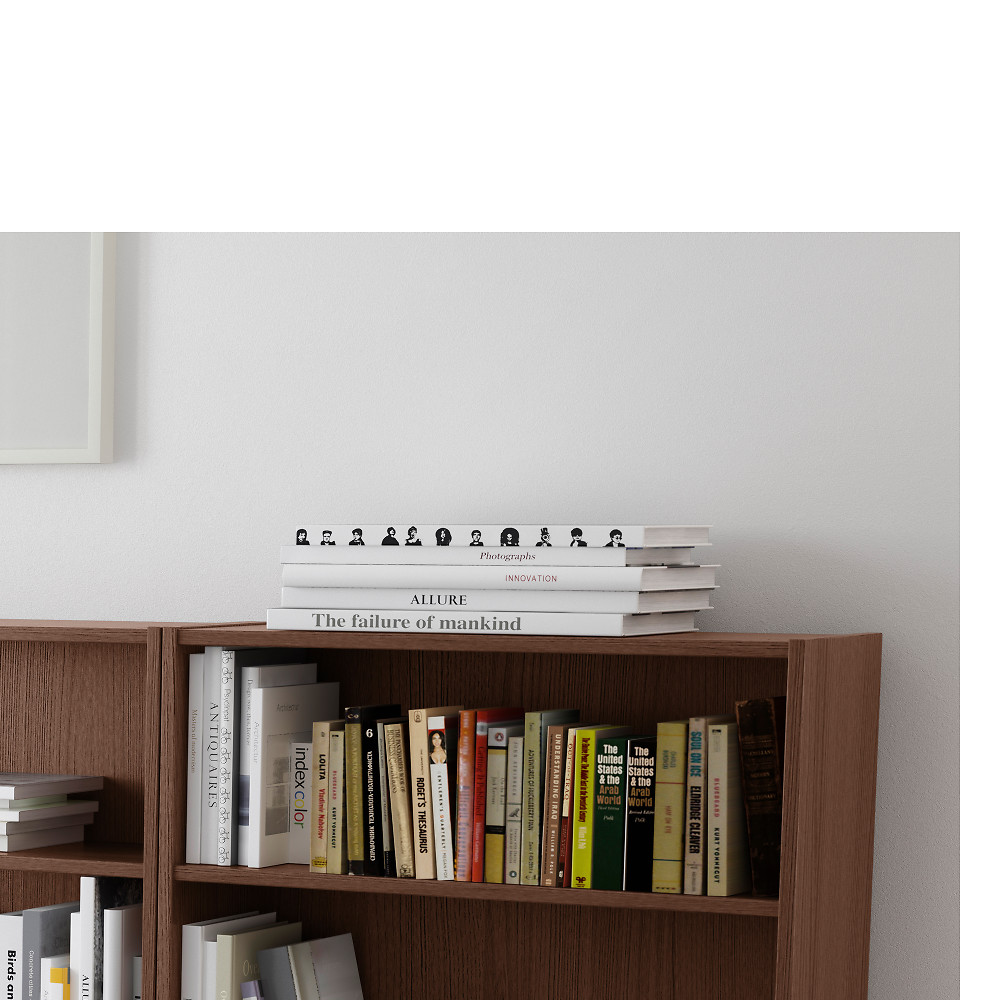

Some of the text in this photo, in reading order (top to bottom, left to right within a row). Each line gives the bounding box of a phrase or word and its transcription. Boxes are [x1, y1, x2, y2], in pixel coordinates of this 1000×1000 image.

[480, 551, 536, 562] Photographs
[505, 574, 558, 583] INNOVATION
[410, 594, 467, 606] ALLURE
[311, 613, 522, 631] The failure of mankind
[365, 728, 374, 738] 6
[602, 744, 618, 754] The
[633, 747, 649, 757] The
[207, 702, 219, 809] ANTIQUAIRES
[597, 754, 624, 764] United
[552, 733, 561, 799] UNDERSTANDING
[628, 757, 655, 767] United
[318, 754, 326, 781] LOLITA
[597, 765, 624, 774] States
[628, 767, 655, 777] States
[599, 775, 620, 785] & the
[630, 777, 652, 787] & the
[294, 747, 309, 829] index color
[415, 777, 426, 808] ROGET'S
[599, 785, 620, 795] Arab
[630, 787, 651, 797] Arab
[689, 731, 702, 854] SOUL ON ICE ELDRIDGE CLEAVER
[318, 788, 326, 813] Vladimir
[596, 795, 622, 805] World
[628, 797, 653, 807] World
[551, 801, 559, 820] IRAQ
[664, 805, 672, 816] HAM
[418, 811, 428, 854] THESAURUS
[664, 825, 672, 834] RYE
[6, 949, 17, 981] Birds
